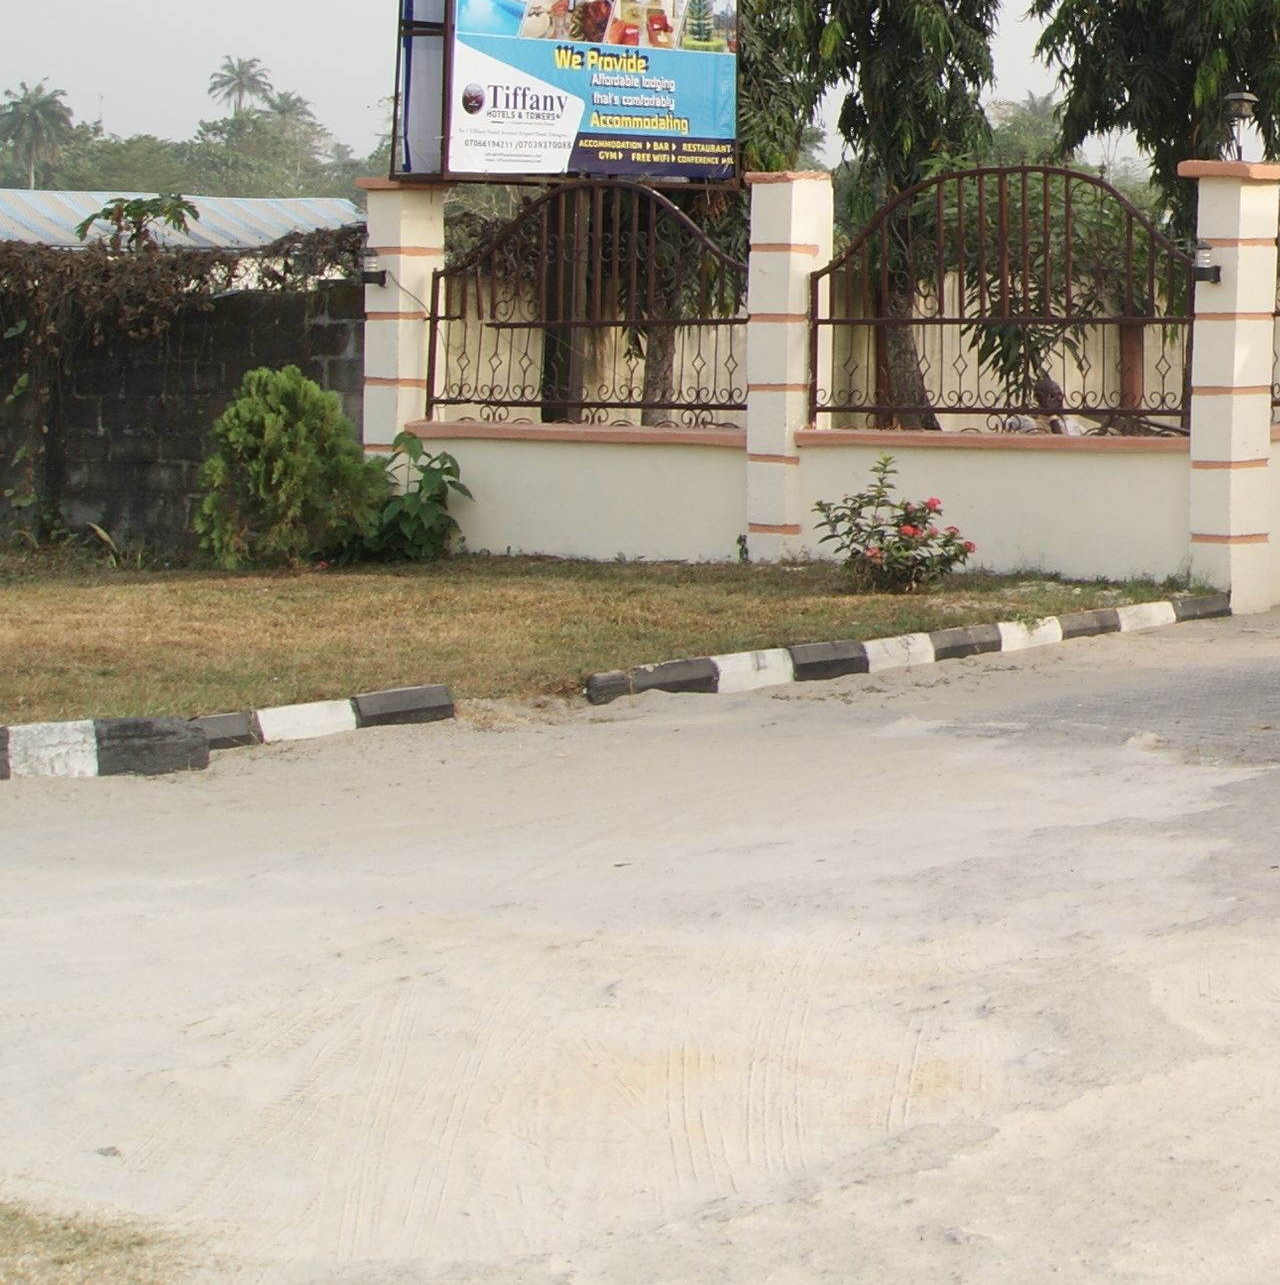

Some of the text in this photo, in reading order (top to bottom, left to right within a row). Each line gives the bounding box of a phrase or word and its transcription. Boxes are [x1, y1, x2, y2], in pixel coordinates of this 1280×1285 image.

[554, 46, 649, 74] We Provide
[591, 73, 675, 93] Affordable lodging
[487, 84, 568, 117] Tiffany
[621, 93, 675, 110] comfortably
[486, 109, 556, 121] HOTELS & TOWERS
[590, 110, 690, 134] Accommodating
[578, 139, 732, 153] ACCOMMODATION BAR RESTAURANT
[598, 150, 617, 161] GYM
[631, 152, 651, 162] FREE
[677, 155, 719, 165] CONFERENCE
